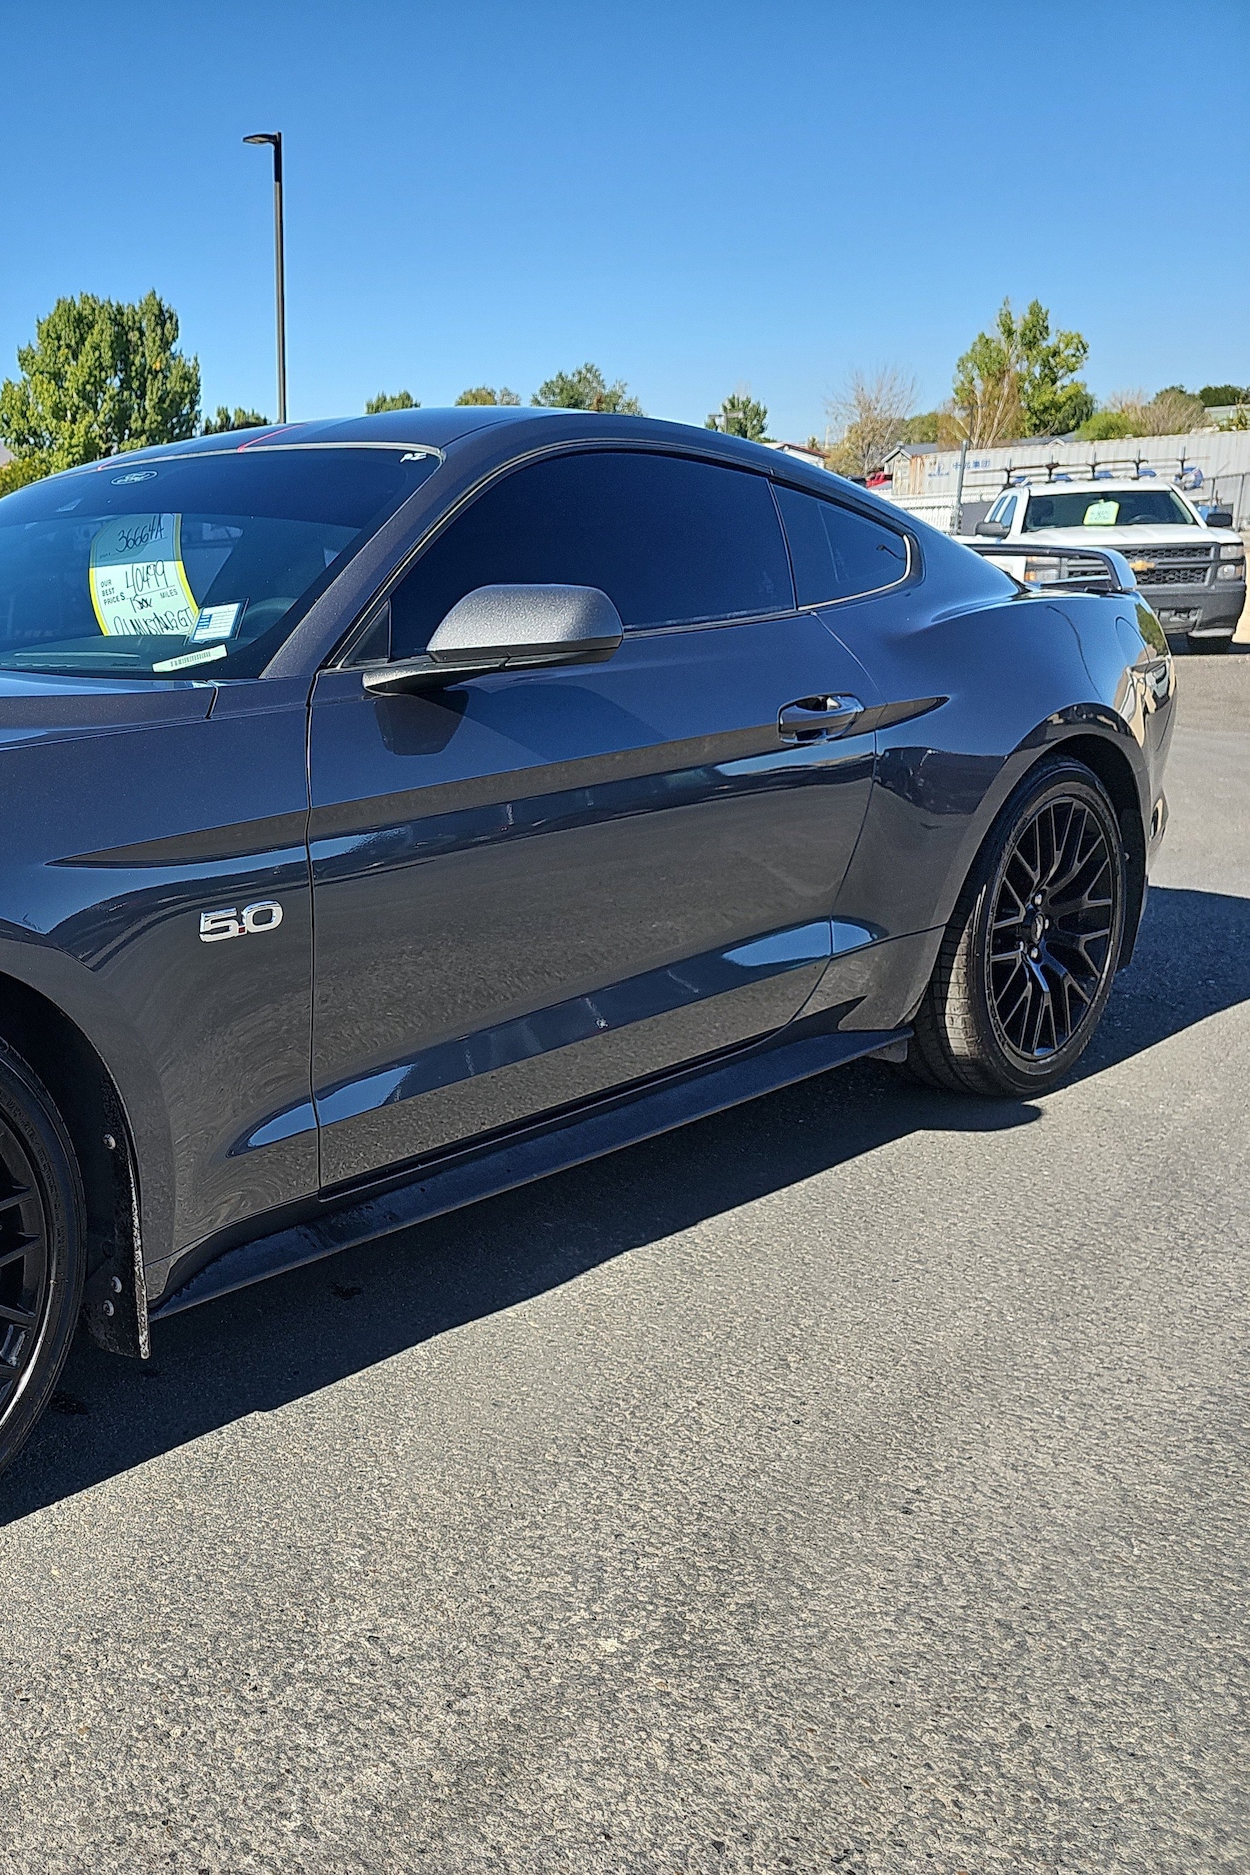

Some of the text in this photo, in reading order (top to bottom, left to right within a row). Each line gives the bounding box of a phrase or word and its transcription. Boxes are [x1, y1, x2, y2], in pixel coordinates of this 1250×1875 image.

[101, 579, 112, 588] OUR
[102, 587, 115, 597] BEST
[160, 589, 179, 599] MILES
[199, 900, 284, 943] 5.0
